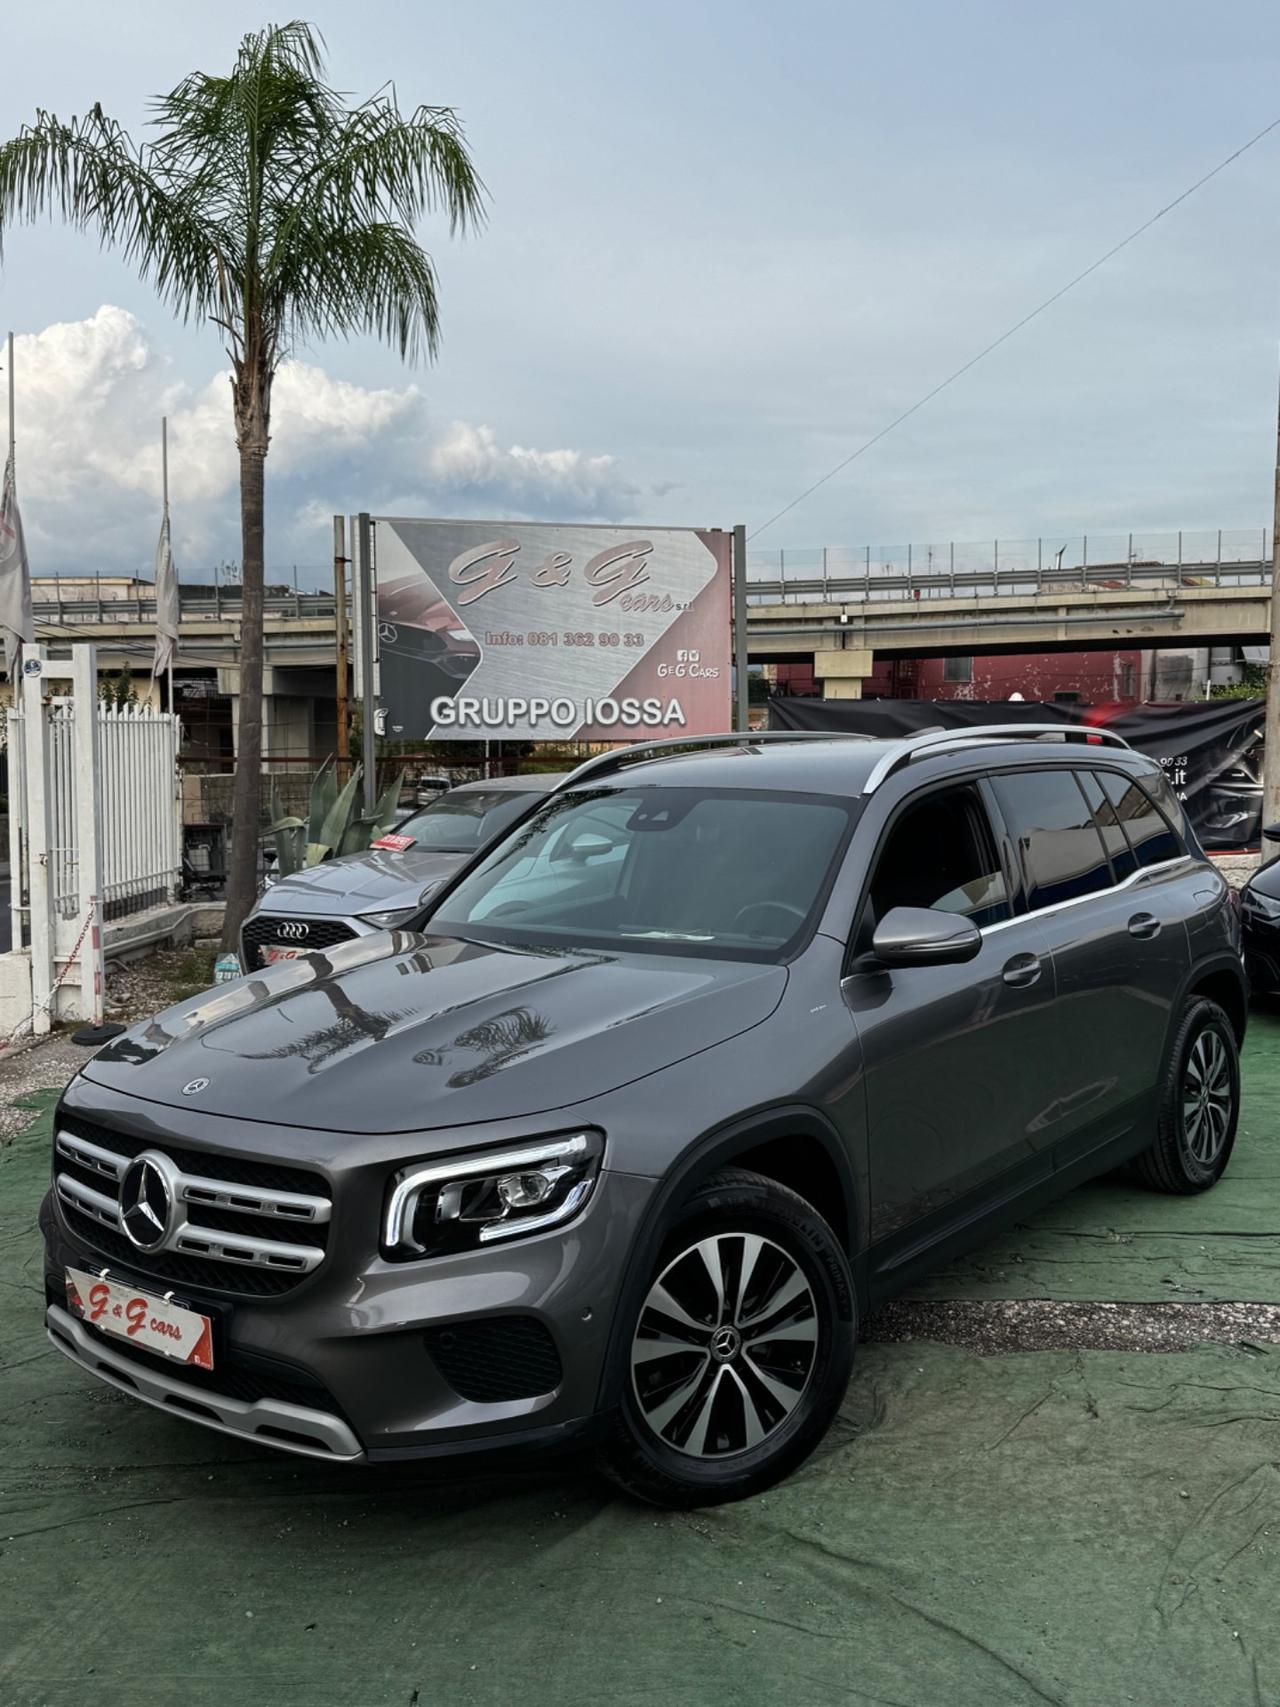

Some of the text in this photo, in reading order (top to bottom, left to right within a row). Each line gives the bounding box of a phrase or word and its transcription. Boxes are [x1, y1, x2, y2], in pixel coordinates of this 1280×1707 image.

[529, 551, 572, 588] &
[485, 631, 645, 647] Info: 081 362 90 33
[430, 696, 687, 727] GRUPPO IOSSA
[1174, 756, 1187, 766] 33
[88, 1284, 182, 1341] G & G cars
